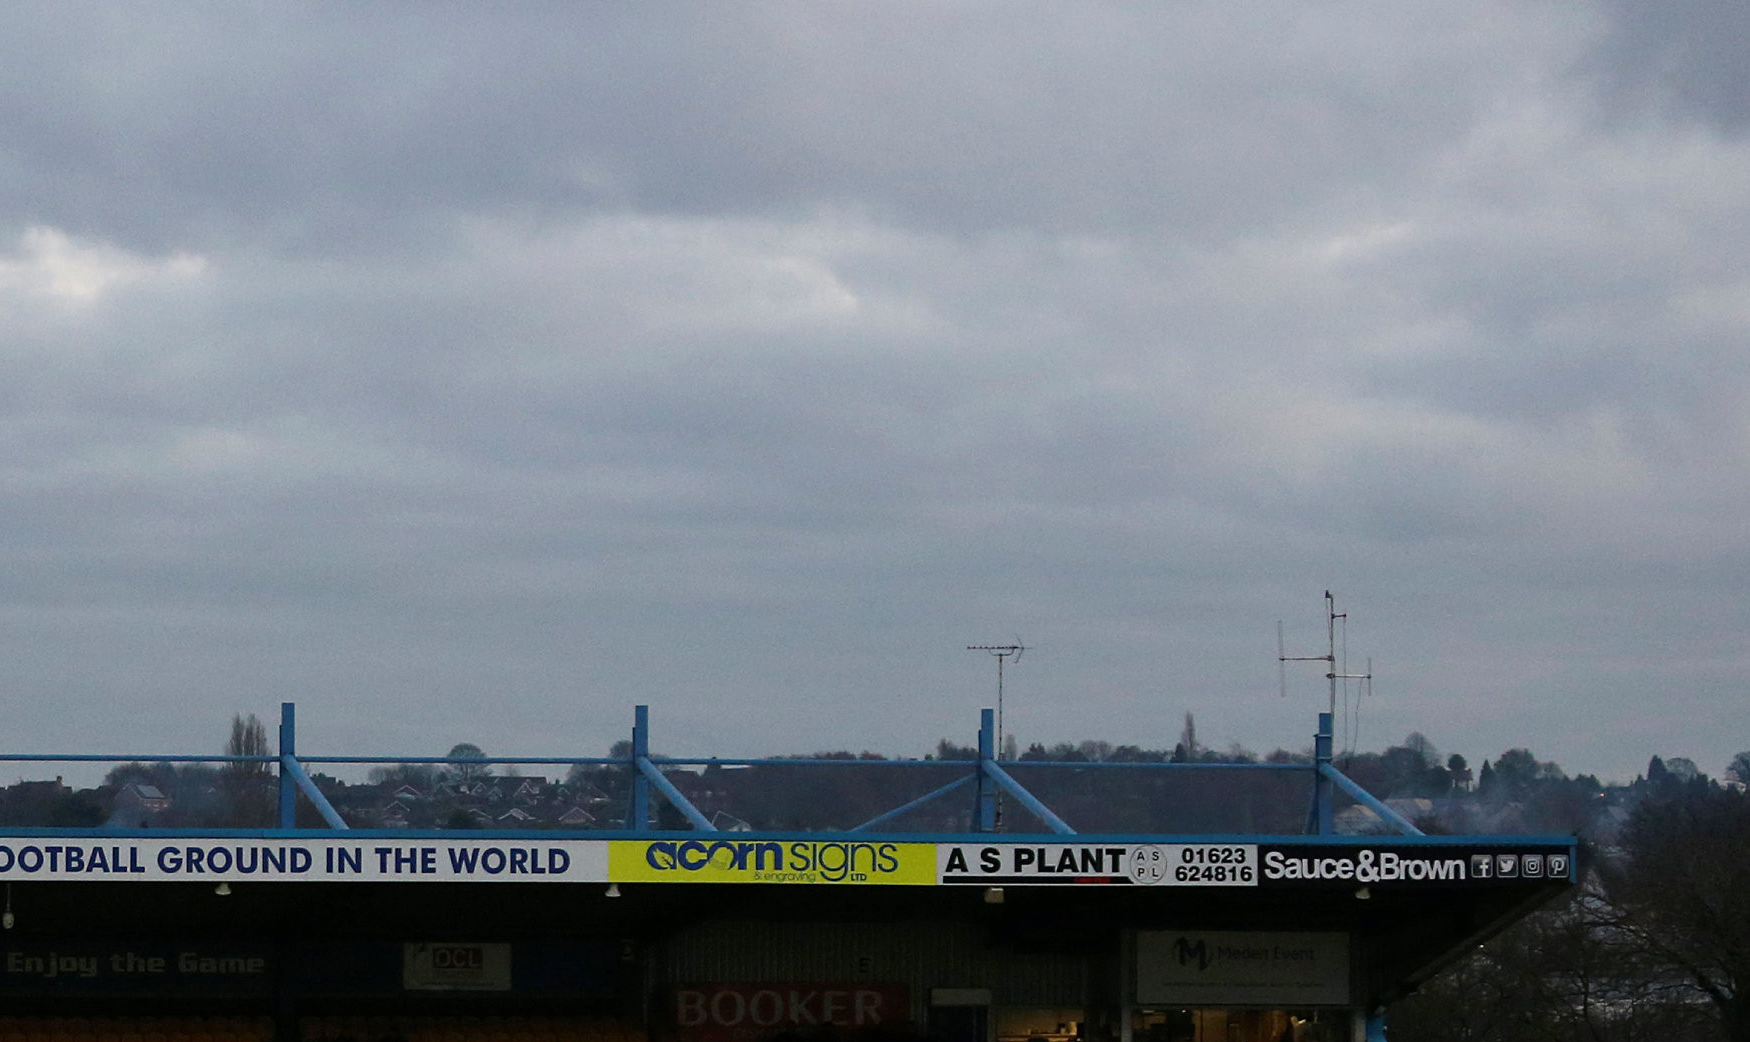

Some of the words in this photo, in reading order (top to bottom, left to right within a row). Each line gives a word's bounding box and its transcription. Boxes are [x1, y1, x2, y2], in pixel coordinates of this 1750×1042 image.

[156, 845, 313, 875] GROUND
[325, 846, 362, 874] IN
[374, 846, 437, 874] THE
[448, 846, 571, 874] WORLD
[646, 840, 783, 871] acorn
[790, 842, 899, 882] signs
[945, 848, 969, 873] A
[980, 847, 1001, 873] S
[1014, 848, 1126, 873] PLANT
[1181, 848, 1246, 864] 01623
[764, 872, 816, 882] engraving
[850, 873, 867, 881] LTD
[1175, 866, 1253, 882] 624816
[6, 952, 98, 978] Enjoy
[110, 952, 166, 973] the
[178, 952, 265, 973] Game
[434, 949, 483, 969] OCL
[677, 989, 884, 1027] BOOKER
